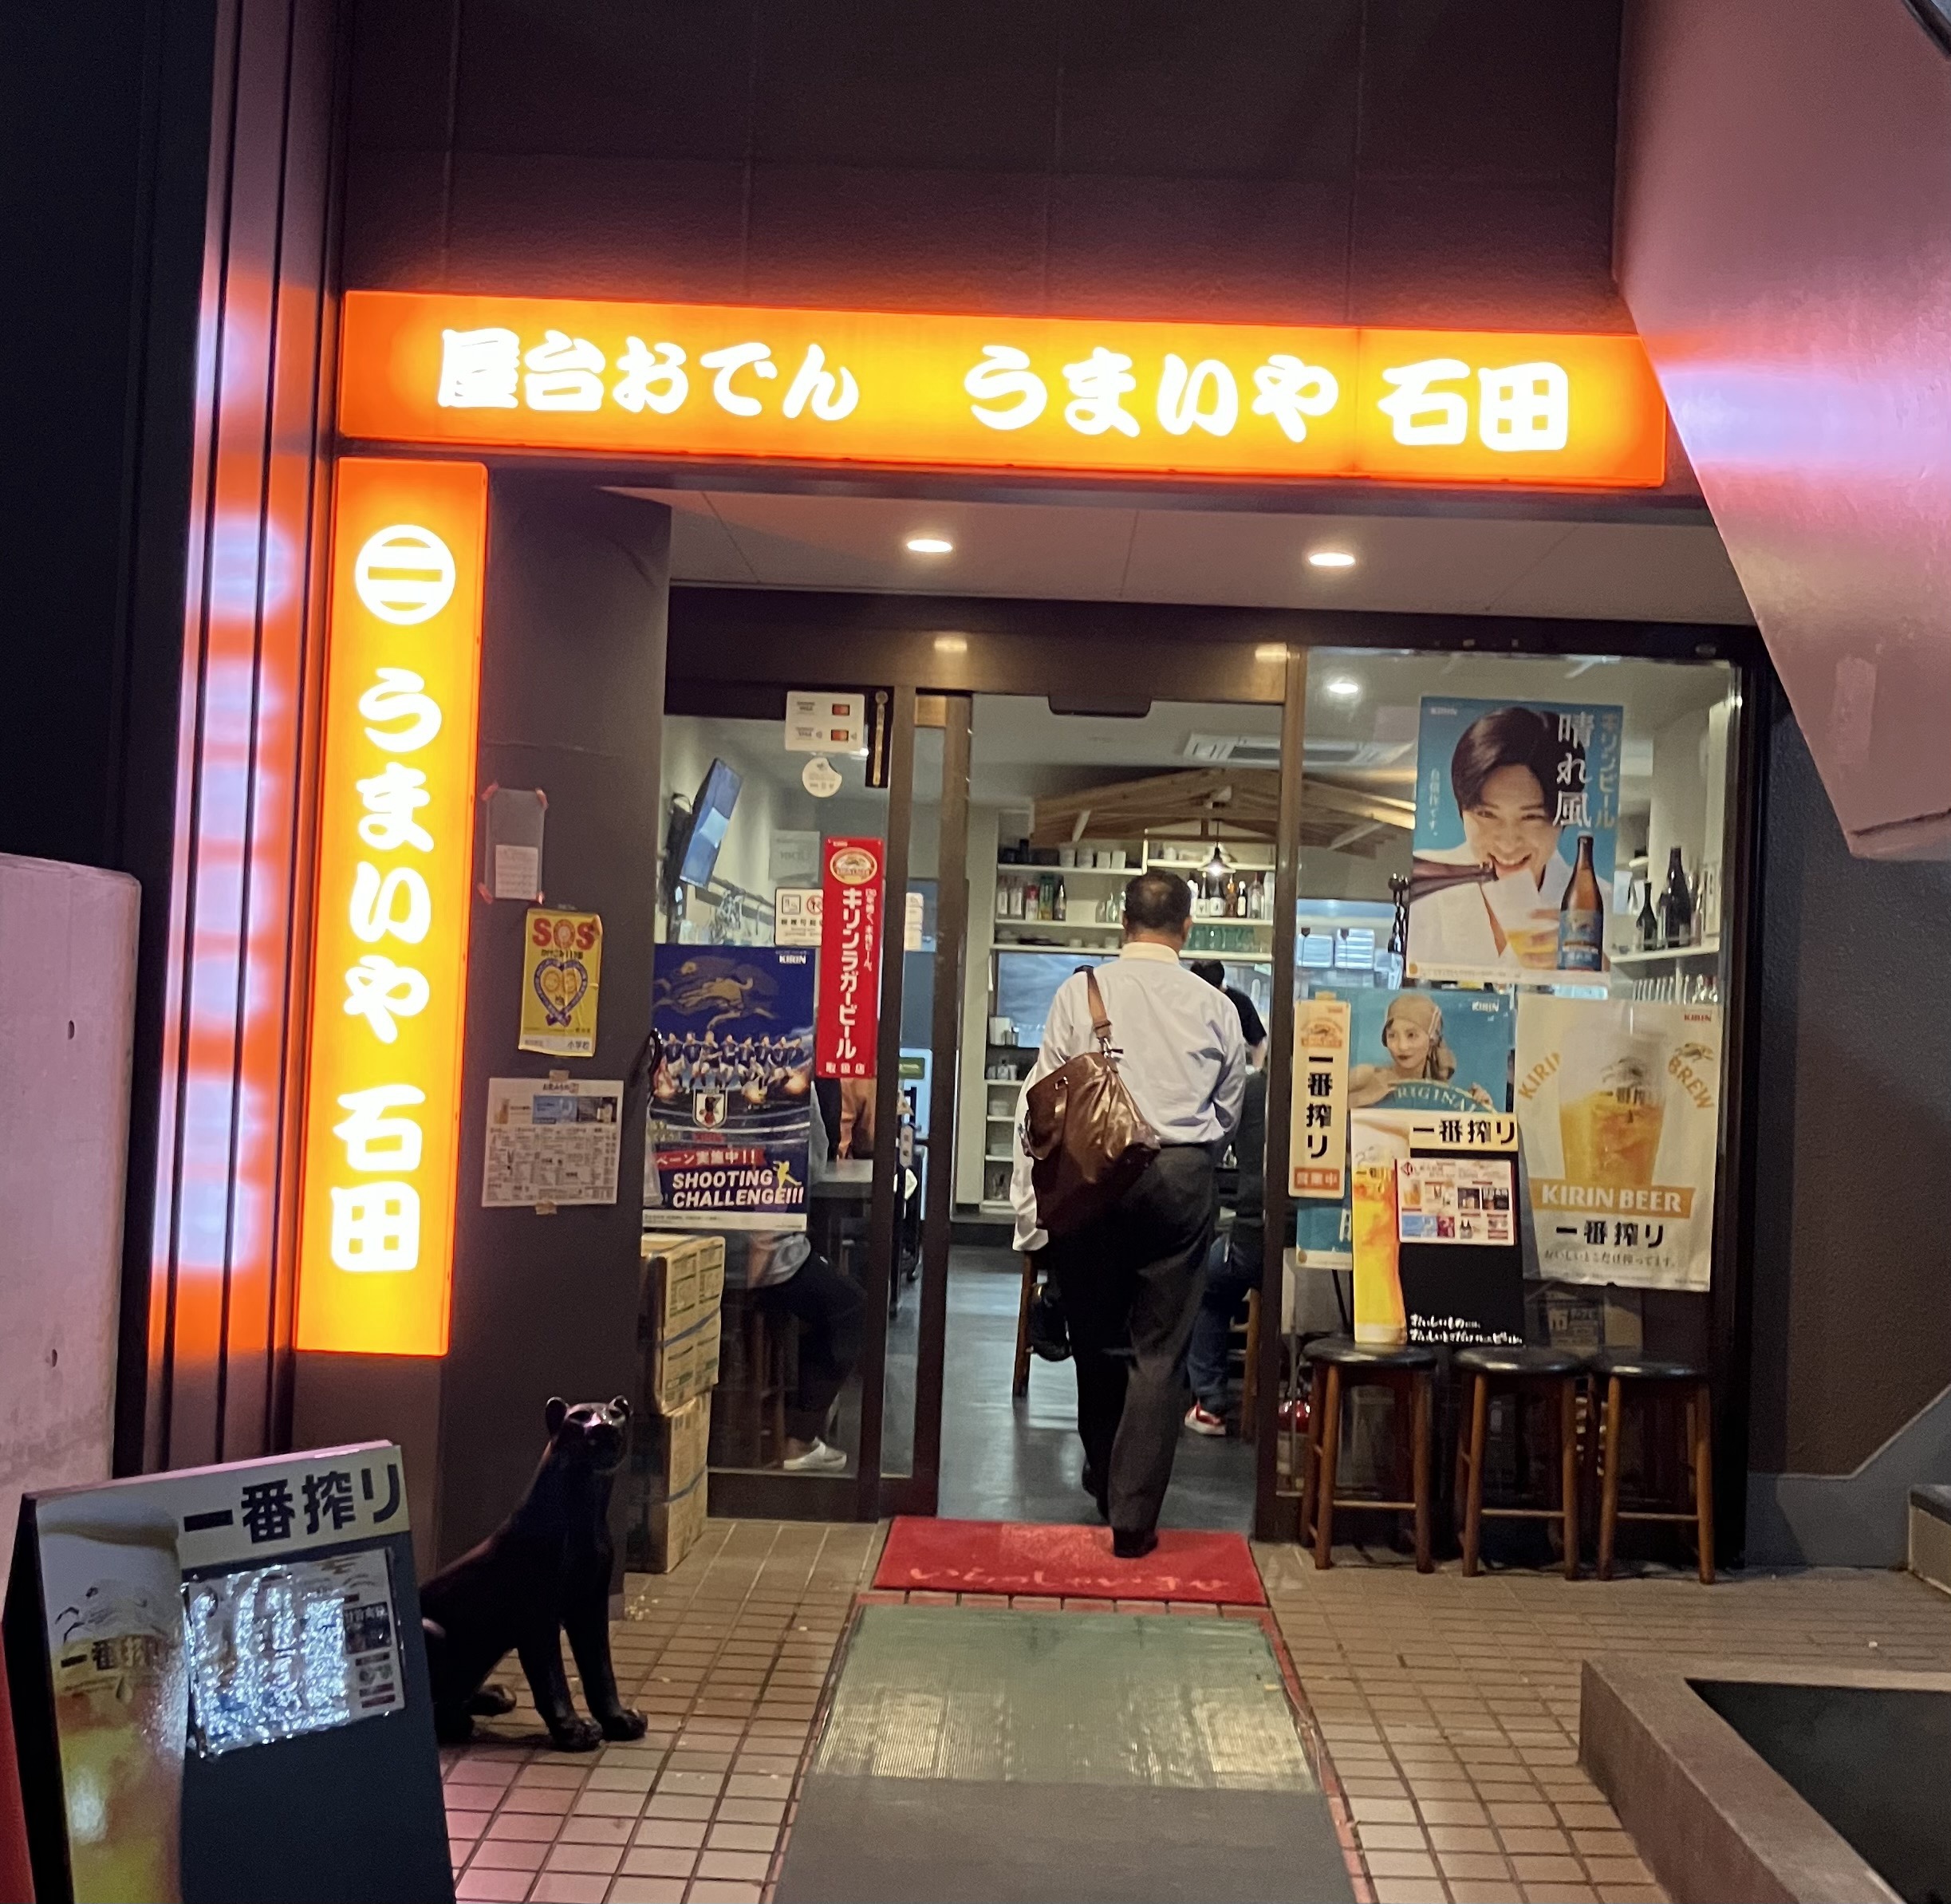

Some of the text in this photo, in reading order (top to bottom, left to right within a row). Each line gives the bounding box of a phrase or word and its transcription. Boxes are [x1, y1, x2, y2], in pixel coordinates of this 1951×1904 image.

[437, 327, 1569, 452] 屋台おでん うまいや 石田
[1552, 712, 1594, 828] 晴れ風
[532, 917, 595, 950] SOS
[329, 667, 443, 1272] うまいや 石田
[778, 955, 806, 964] KIRIN
[836, 887, 862, 1059] キリンラガービール
[1472, 1000, 1500, 1011] KIRIN
[1684, 1013, 1712, 1022] KIRIN
[1307, 1056, 1333, 1158] 一番搾り
[1413, 1119, 1515, 1145] 一番搾り
[672, 1169, 773, 1190] SHOOTING
[1541, 1184, 1682, 1213] KIRIN BEER
[1556, 1220, 1664, 1248] 一番搾り
[183, 1462, 400, 1545] 一番搾り
